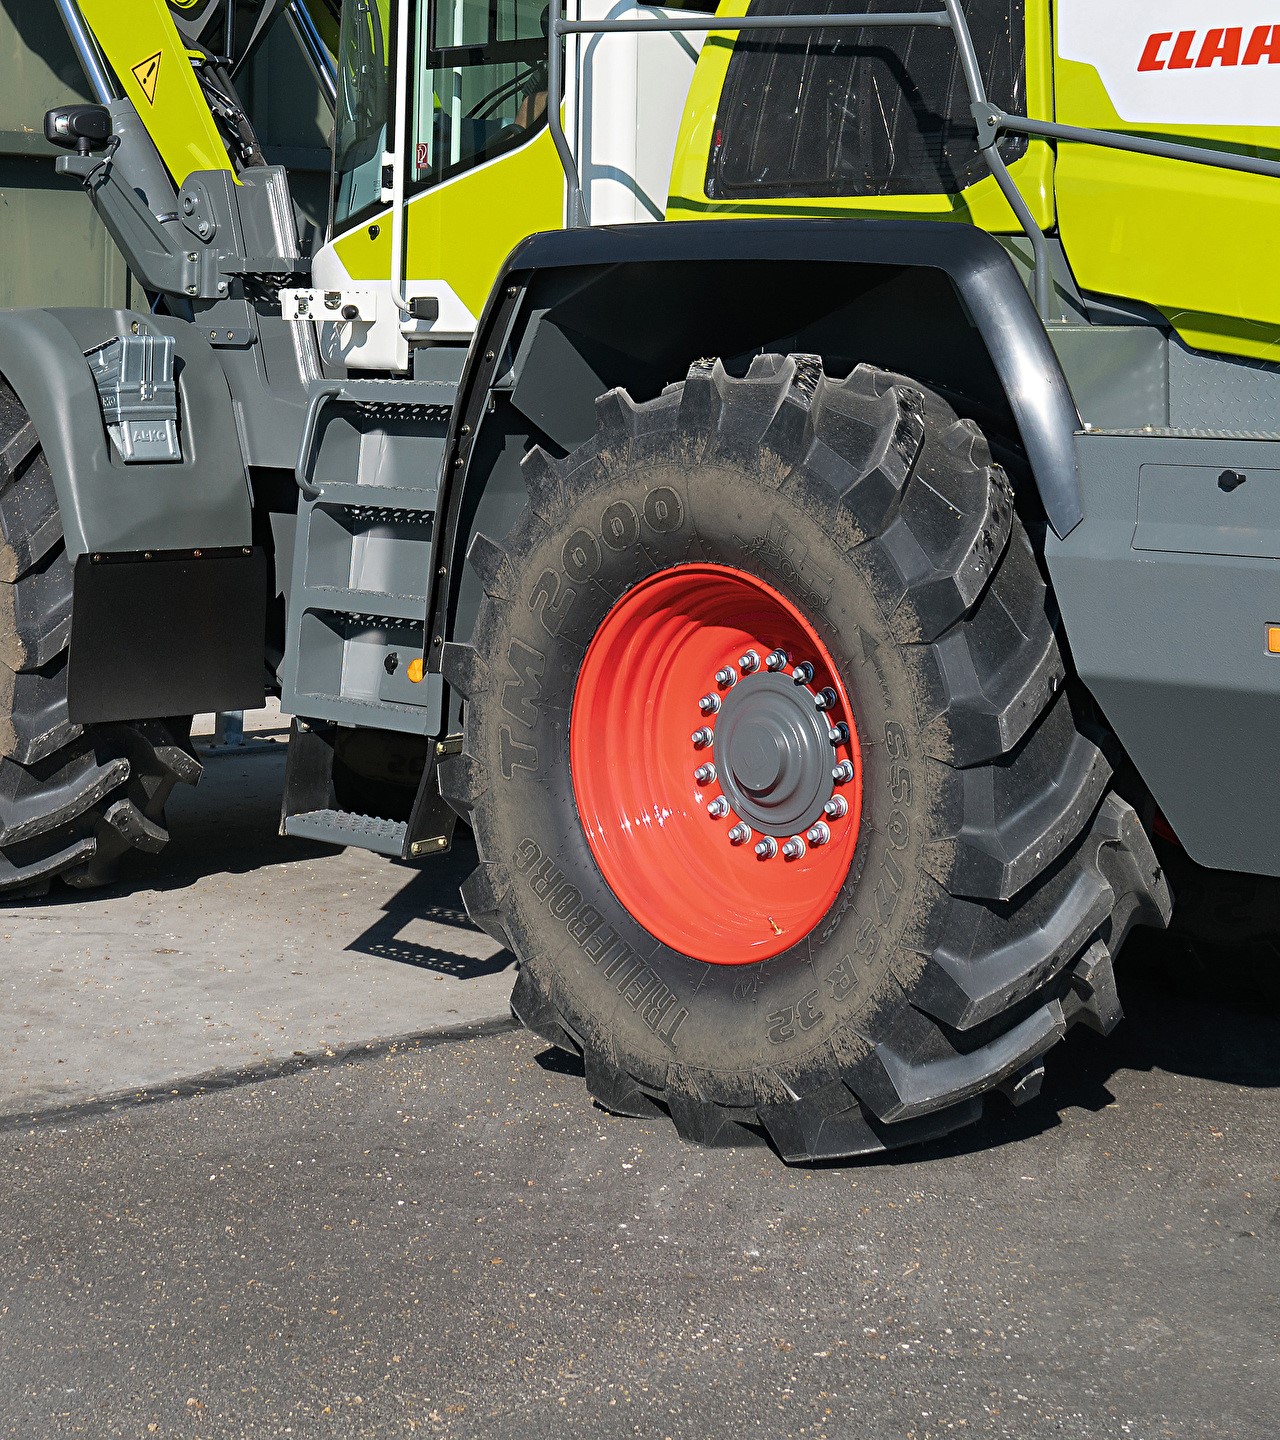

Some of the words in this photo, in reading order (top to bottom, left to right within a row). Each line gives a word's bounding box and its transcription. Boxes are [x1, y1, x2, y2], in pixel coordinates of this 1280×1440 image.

[498, 636, 546, 781] TM
[528, 486, 685, 638] 2000
[512, 837, 690, 1054] TRELLEBORG
[766, 989, 824, 1045] 32
